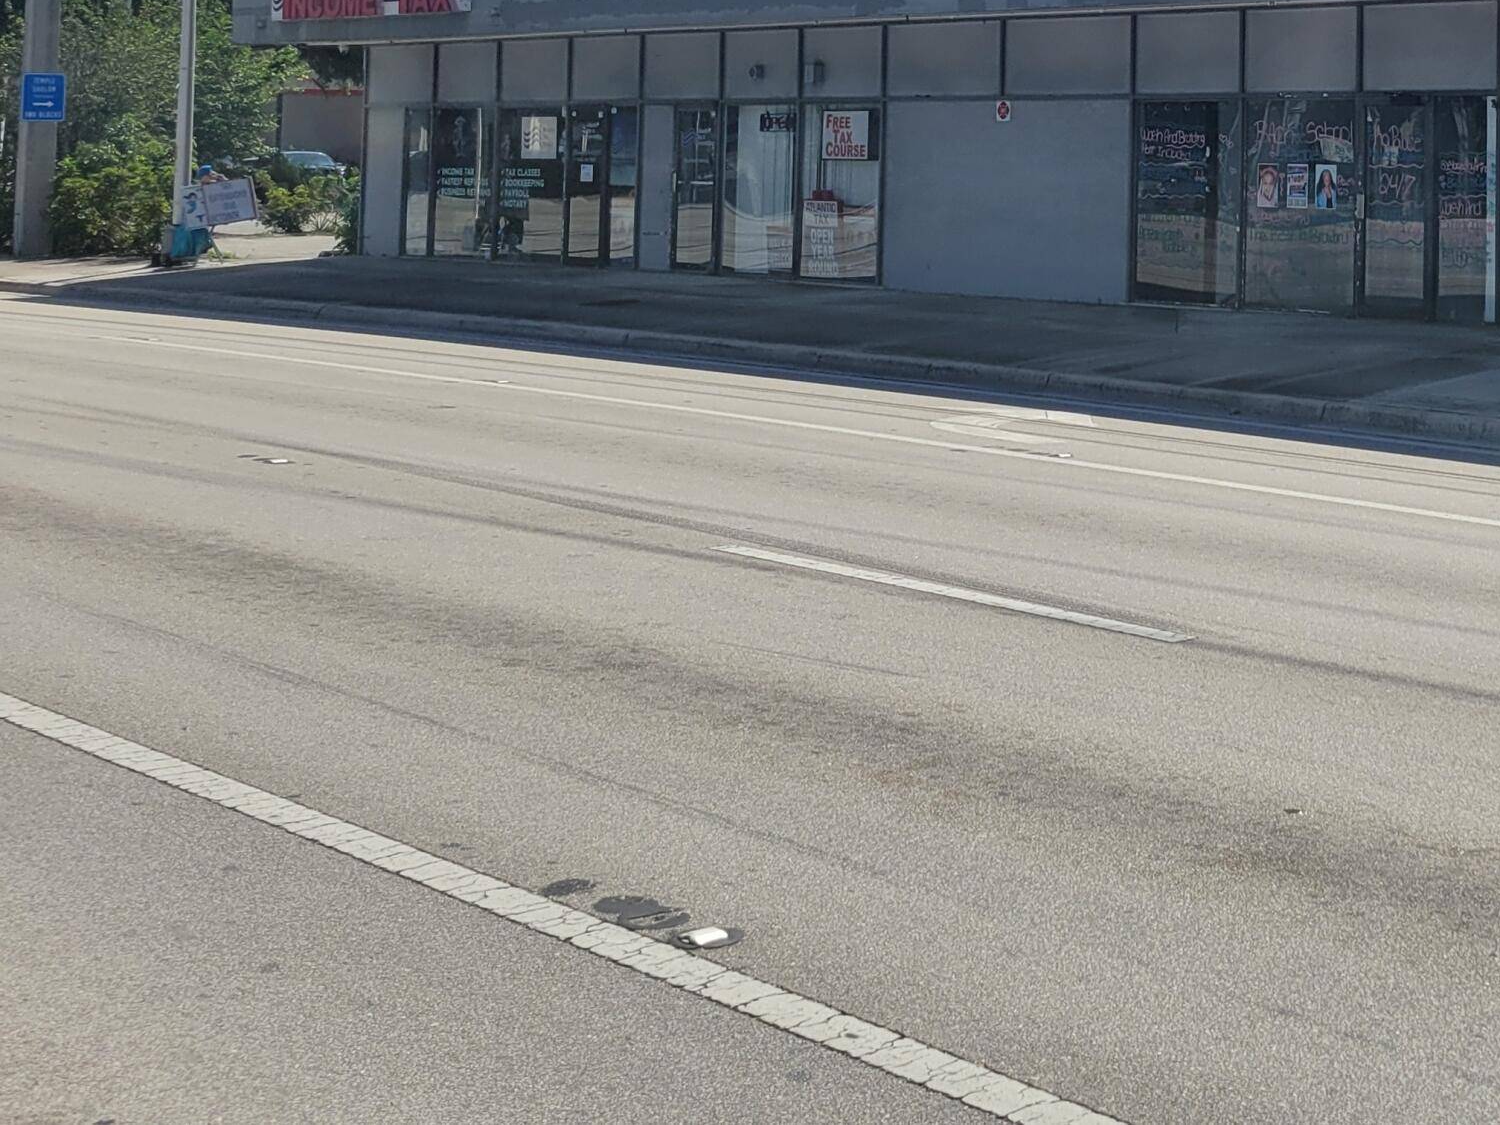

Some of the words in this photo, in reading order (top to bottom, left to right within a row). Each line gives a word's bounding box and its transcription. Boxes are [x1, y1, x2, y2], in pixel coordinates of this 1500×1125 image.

[826, 114, 852, 129] FREE
[832, 129, 853, 144] TAX
[825, 142, 866, 157] COURSE
[810, 228, 835, 245] OPEN
